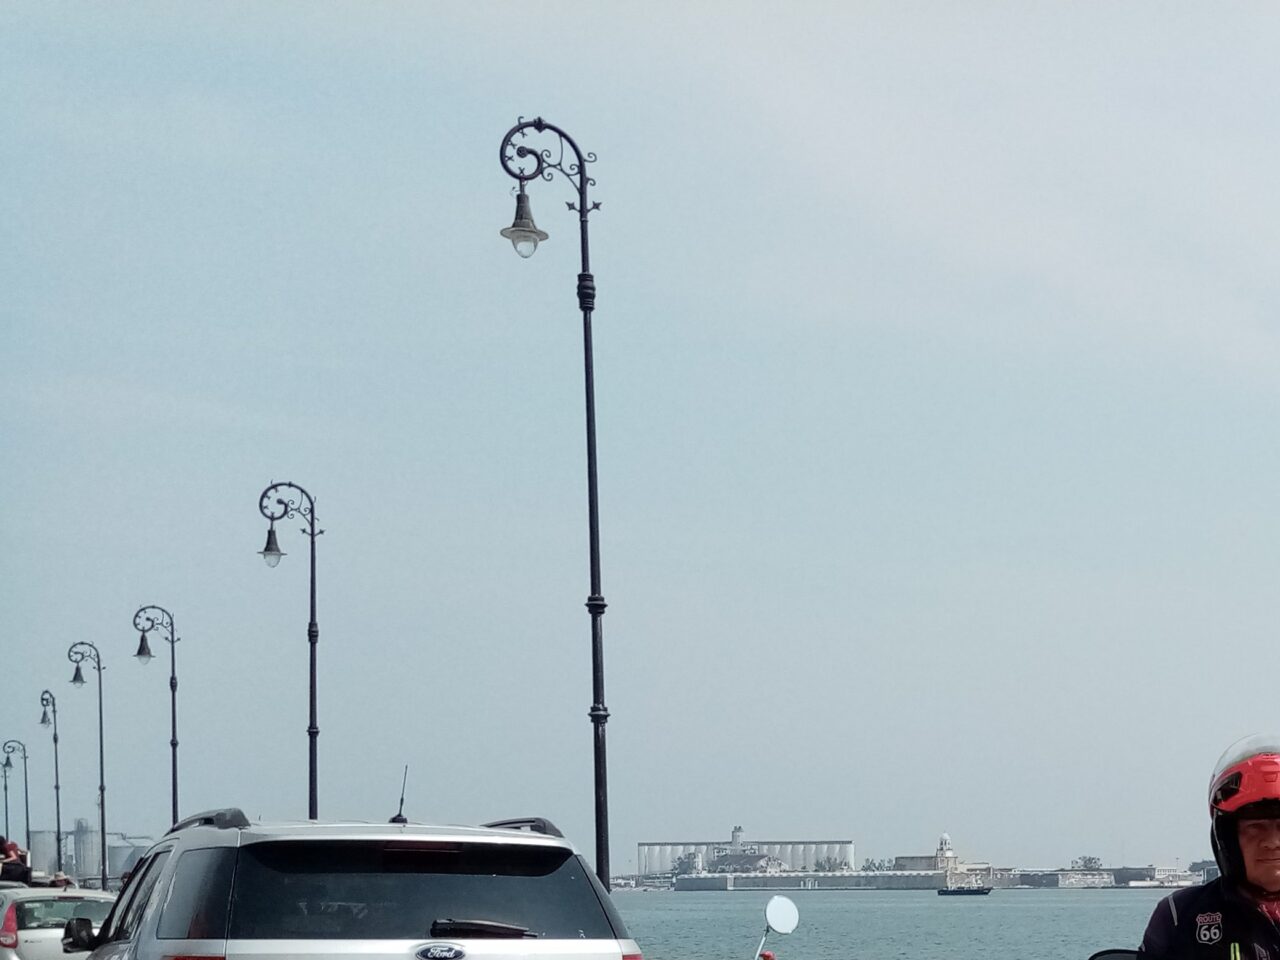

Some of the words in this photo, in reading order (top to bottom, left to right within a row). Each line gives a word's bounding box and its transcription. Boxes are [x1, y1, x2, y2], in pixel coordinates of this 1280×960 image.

[1199, 914, 1221, 923] ROUTE
[1200, 925, 1219, 940] 66
[427, 946, 456, 958] Ford
